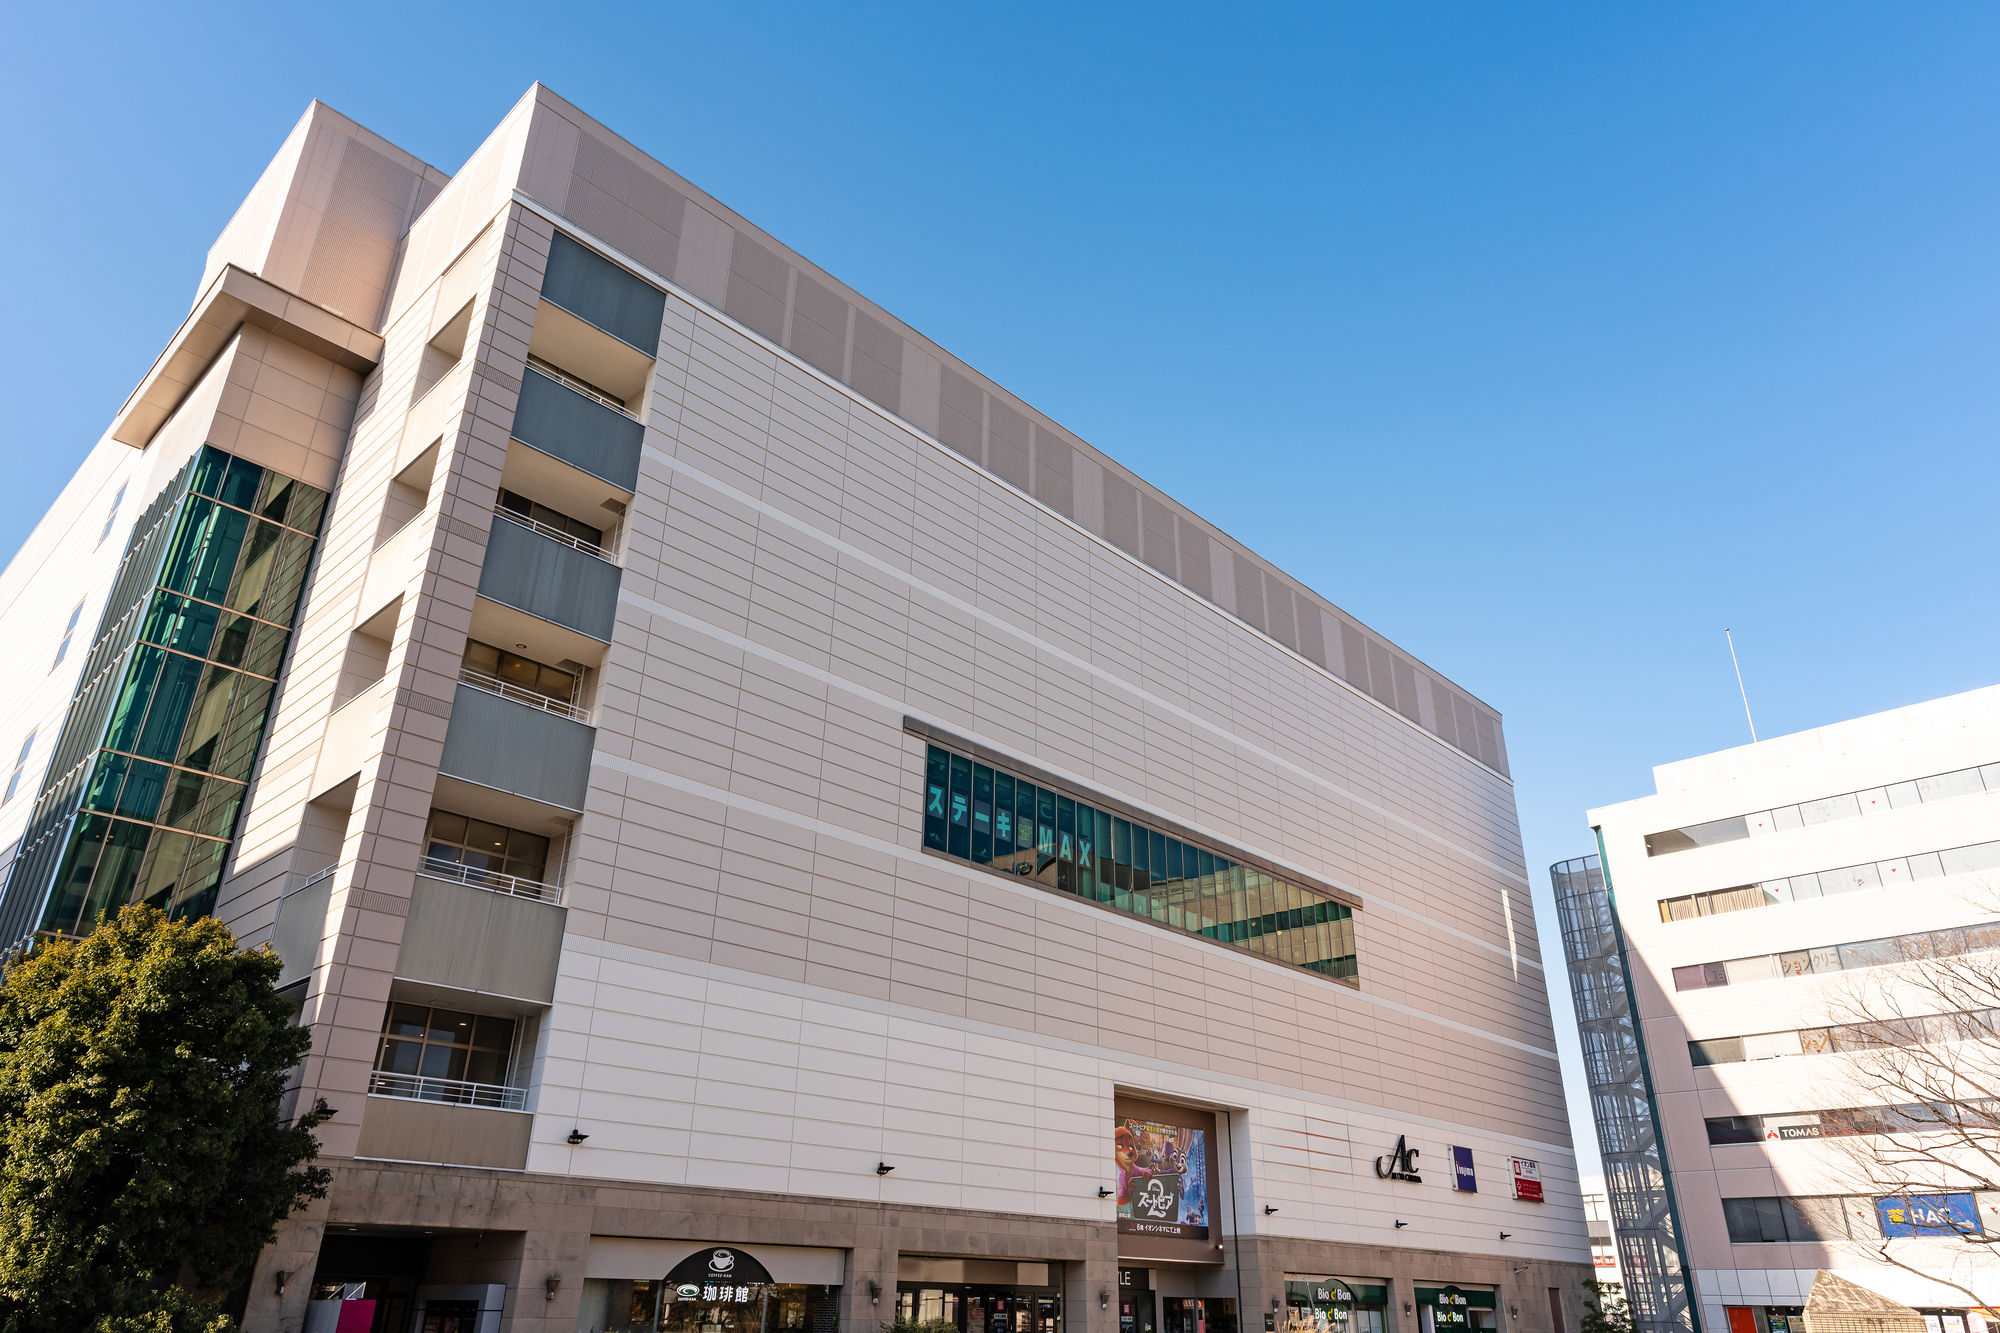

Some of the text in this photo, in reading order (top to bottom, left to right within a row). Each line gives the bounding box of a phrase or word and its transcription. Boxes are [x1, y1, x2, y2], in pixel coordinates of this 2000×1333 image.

[928, 785, 1092, 868] ステーキ MAX
[1781, 1127, 1820, 1138] TOMAS
[1137, 1190, 1175, 1211] ズートピア
[702, 1285, 749, 1303] 珈琲館
[1317, 1287, 1330, 1301] Bio
[1337, 1288, 1352, 1301] Bon
[1438, 1293, 1449, 1304] Bio
[1454, 1294, 1467, 1305] Bon
[1314, 1307, 1327, 1320] Bio
[1333, 1308, 1348, 1320] Bon
[1436, 1310, 1447, 1322] Bio
[1452, 1311, 1464, 1323] Bon
